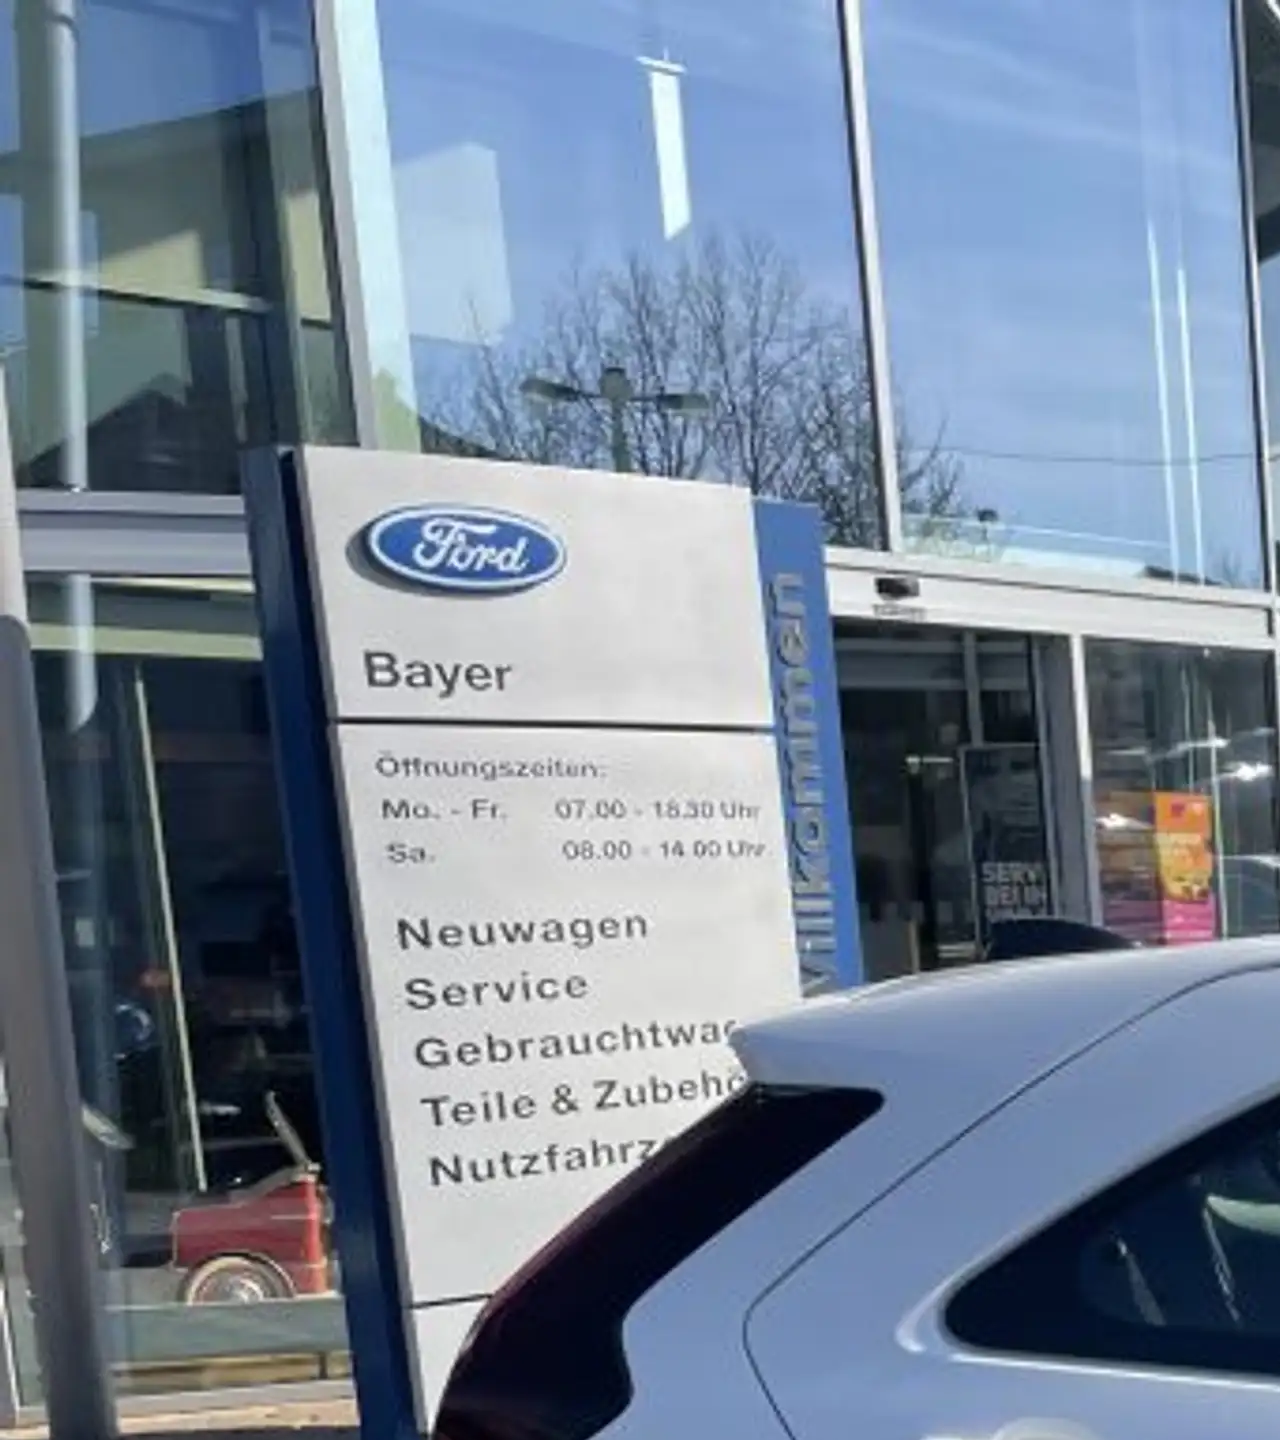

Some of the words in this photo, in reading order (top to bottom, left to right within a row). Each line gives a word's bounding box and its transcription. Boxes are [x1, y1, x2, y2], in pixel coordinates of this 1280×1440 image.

[412, 517, 529, 574] Ford
[363, 651, 512, 699] Bayer
[375, 752, 607, 781] Öffnungszeiten:
[381, 799, 441, 820] Mo.
[472, 799, 507, 820] Fr.
[554, 799, 628, 821] 07.00
[720, 800, 762, 822] Uhr
[386, 844, 436, 864] Sa.
[562, 840, 633, 861] 08.00
[397, 913, 649, 951] Neuwagen
[404, 971, 589, 1011] Service
[421, 1092, 537, 1128] Teile
[552, 1085, 580, 1117] &
[429, 1136, 669, 1187] Nutzfahrz
